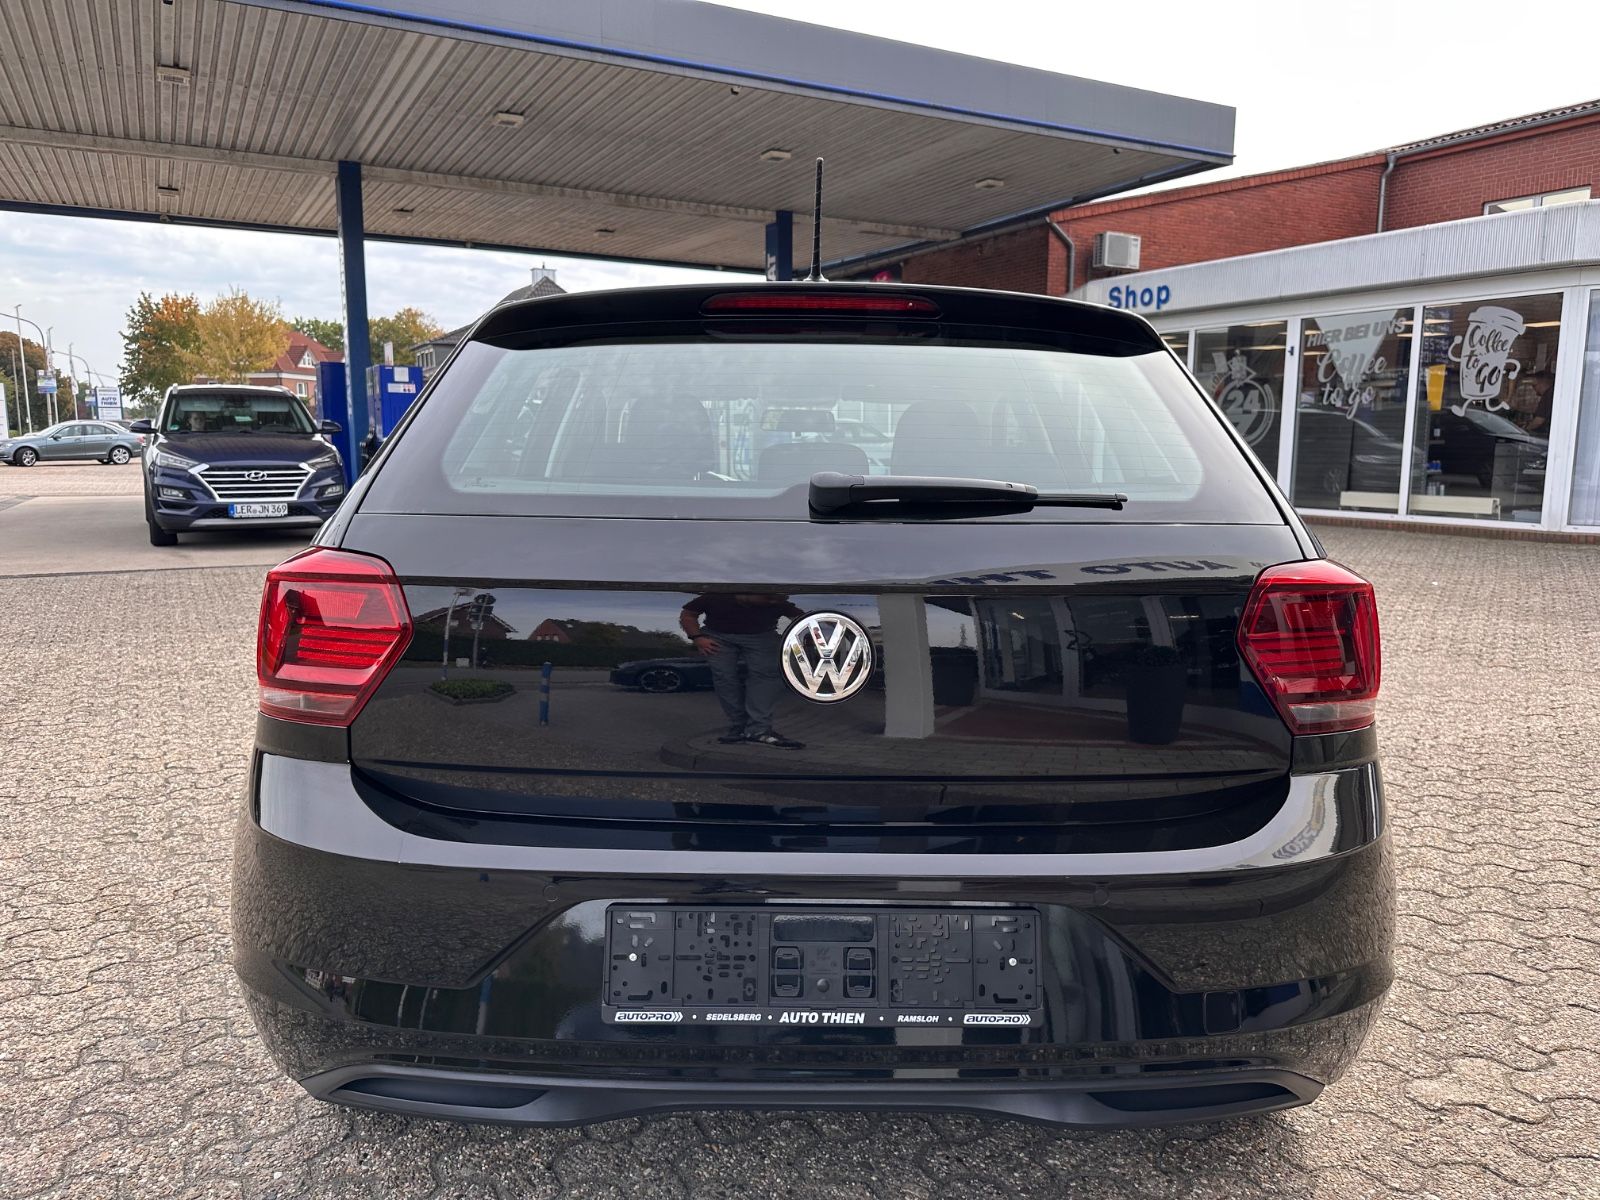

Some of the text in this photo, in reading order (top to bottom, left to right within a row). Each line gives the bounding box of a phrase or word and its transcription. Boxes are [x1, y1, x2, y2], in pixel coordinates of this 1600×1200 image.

[1109, 285, 1170, 309] Shop
[1307, 317, 1407, 347] HIER BEI UNS
[1469, 325, 1509, 353] Coffee
[1317, 348, 1387, 391] Coffee
[1464, 350, 1480, 370] to
[1226, 389, 1261, 415] 24
[1321, 382, 1376, 419] to go
[235, 504, 287, 515] LER JN 369
[706, 1013, 762, 1021] SEDELSBERG
[779, 1011, 819, 1024] AUTO
[821, 1012, 865, 1024] THIEN
[897, 1014, 940, 1023] RAMSLOH
